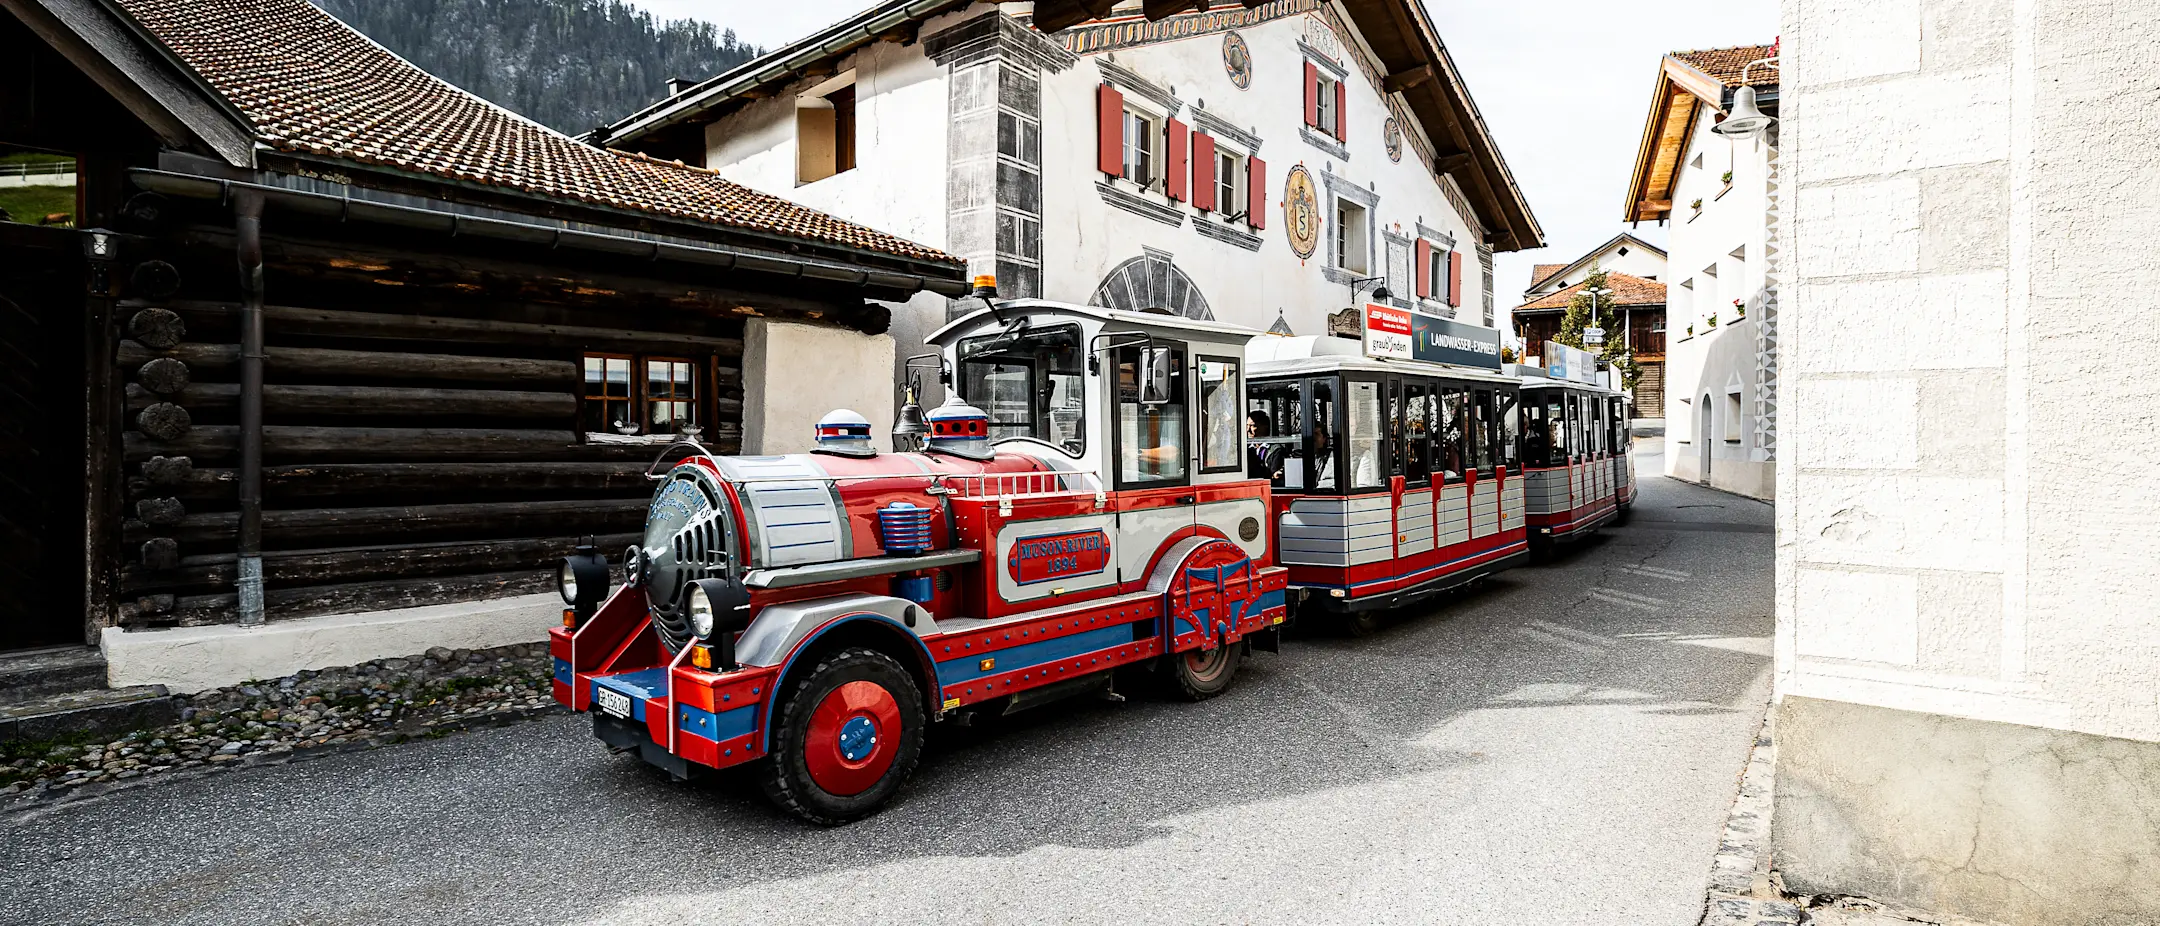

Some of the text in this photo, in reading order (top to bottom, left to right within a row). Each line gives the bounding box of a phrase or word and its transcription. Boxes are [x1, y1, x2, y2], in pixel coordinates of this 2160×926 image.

[1430, 332, 1497, 356] LANDWASSER-EXPRESS
[678, 481, 711, 519] TRAINS
[1047, 555, 1077, 574] 1894
